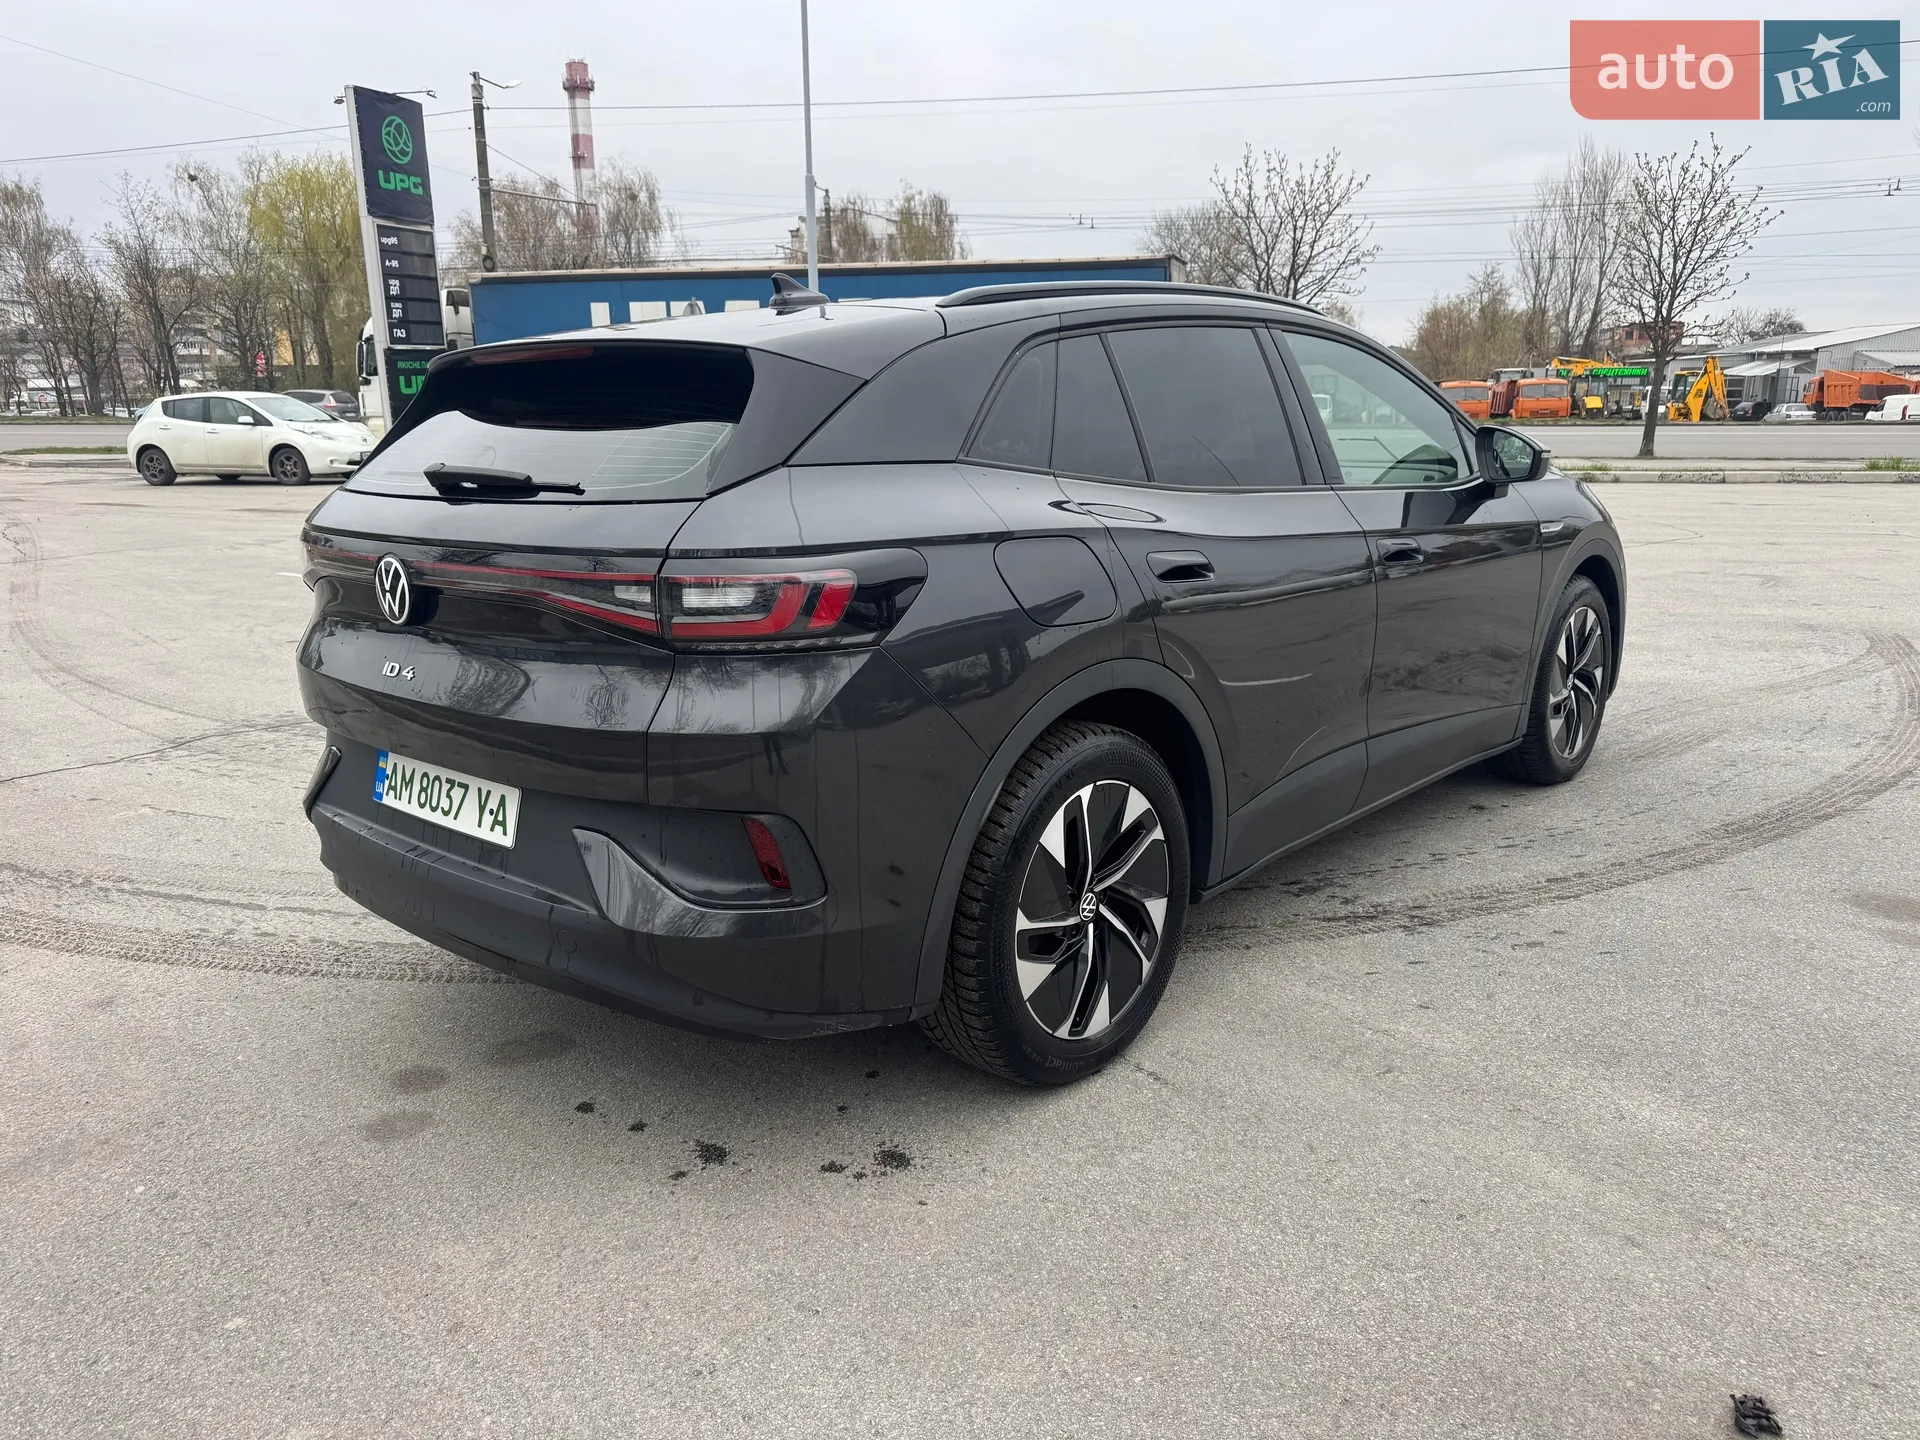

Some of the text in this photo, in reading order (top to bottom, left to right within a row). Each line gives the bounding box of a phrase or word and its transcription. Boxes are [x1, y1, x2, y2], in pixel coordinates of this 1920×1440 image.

[378, 169, 424, 196] UPG
[388, 279, 400, 287] upg
[390, 286, 400, 296] ДП
[392, 309, 403, 319] ДП
[393, 329, 407, 338] ГАЗ
[399, 375, 426, 395] UP
[401, 665, 416, 681] 4
[375, 781, 384, 794] UA
[385, 761, 508, 837] AM 8037 YA
